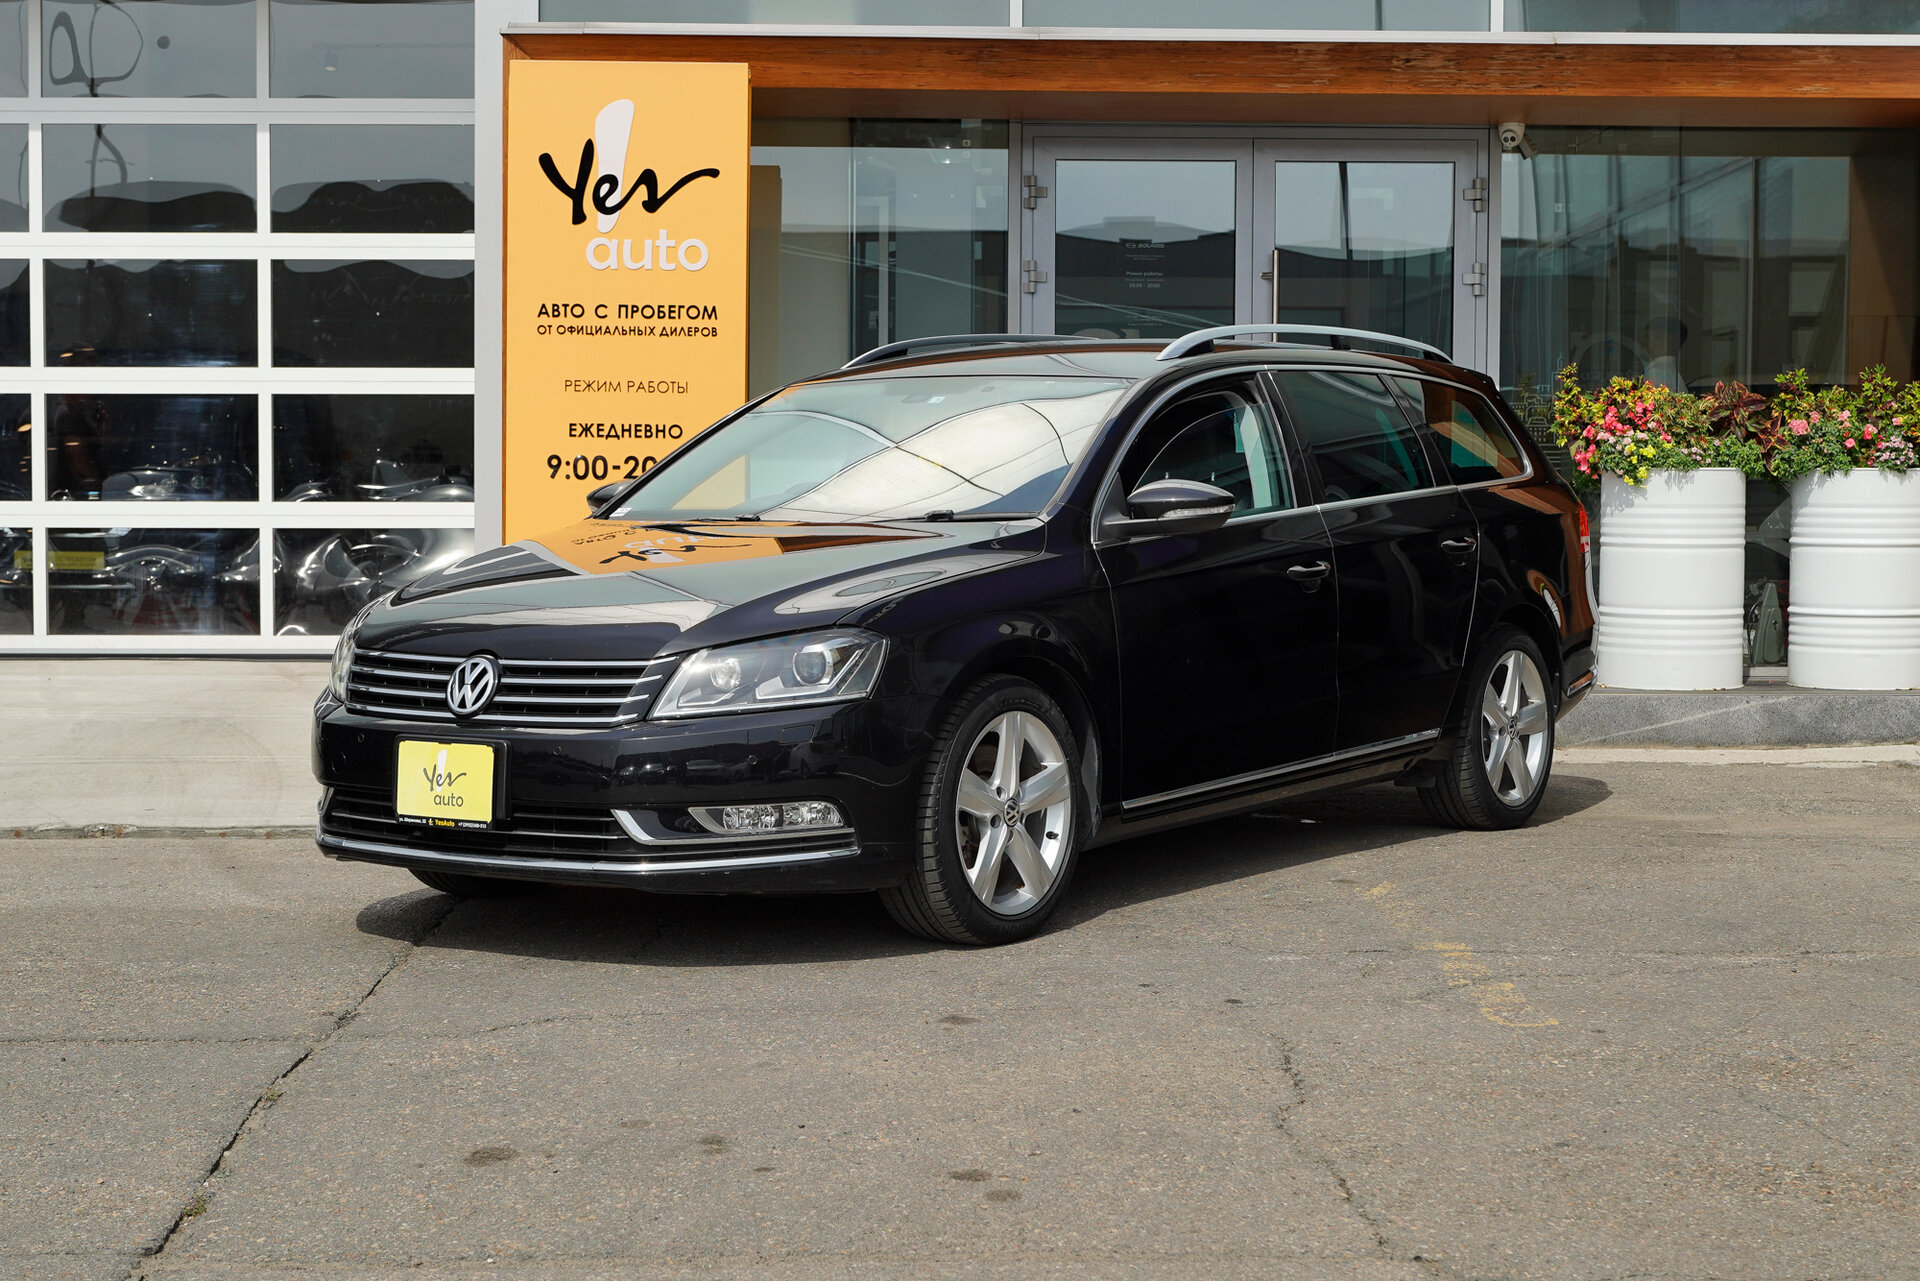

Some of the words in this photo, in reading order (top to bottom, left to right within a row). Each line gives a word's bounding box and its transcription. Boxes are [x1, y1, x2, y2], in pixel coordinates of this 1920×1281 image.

[538, 138, 720, 226] Yes
[586, 229, 709, 271] auto
[537, 303, 585, 319] АВТО
[595, 303, 608, 319] С
[618, 304, 718, 320] ПРОБЕГОМ
[537, 325, 553, 335] ОТ
[556, 325, 656, 337] ОФИЦИАЛЬНЫХ
[659, 326, 718, 338] ДИЛЕРОВ
[564, 379, 622, 393] РЕЖИМ
[627, 380, 689, 394] РАБОТЫ
[568, 423, 684, 440] ЕЖЕДНЕВНО
[422, 763, 467, 792] Yes
[433, 792, 464, 807] auto
[435, 818, 455, 827] YesAuto
